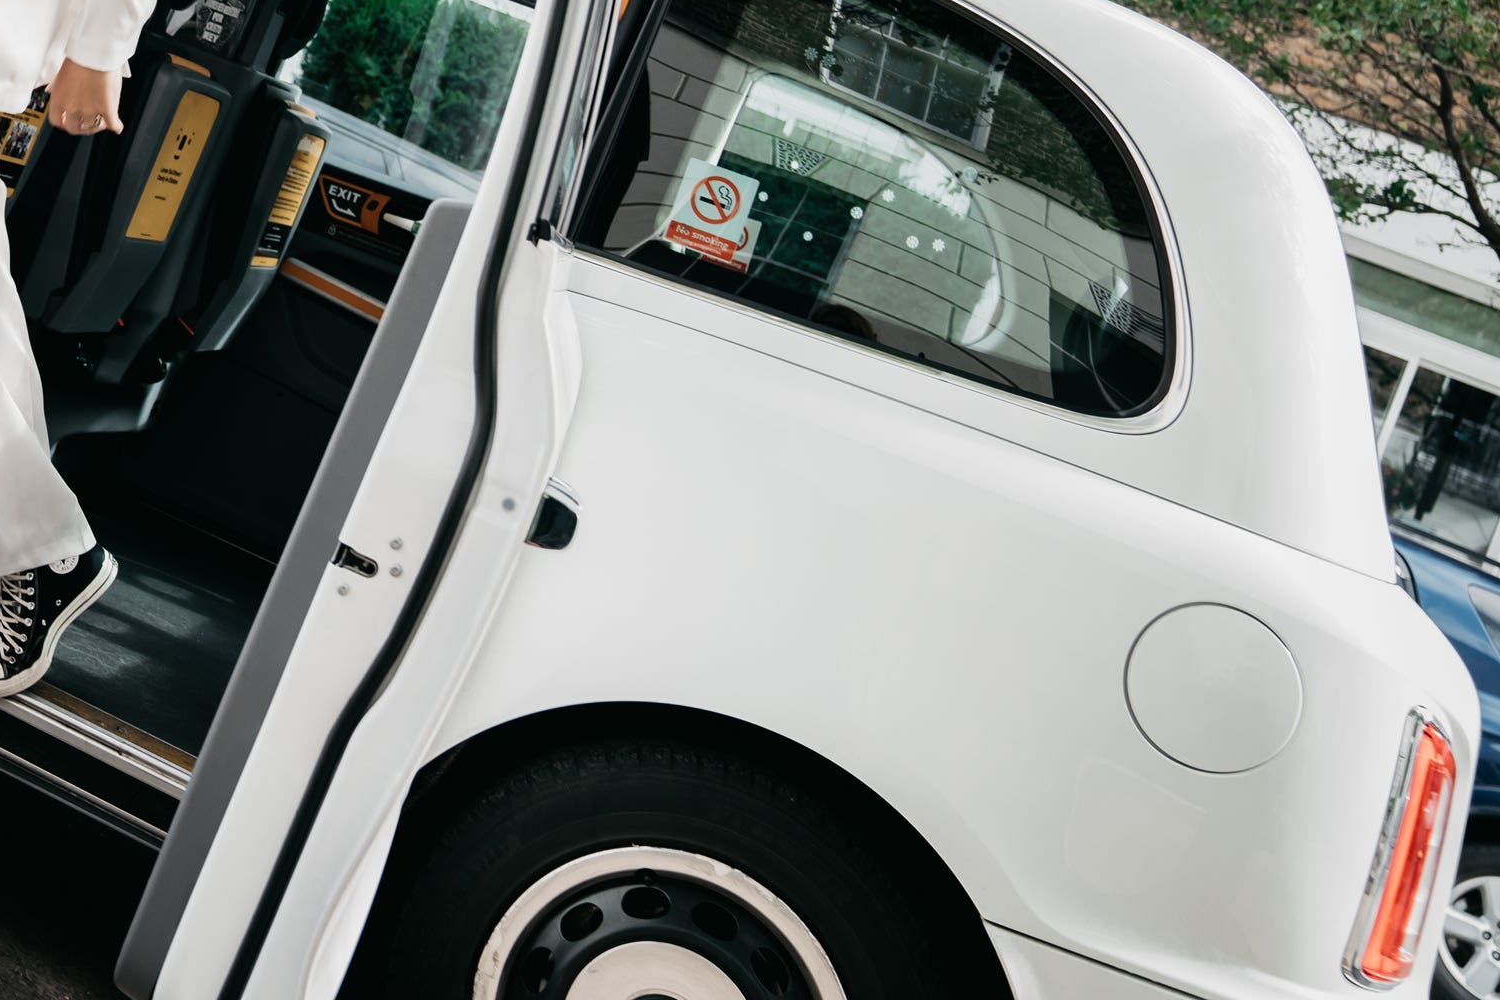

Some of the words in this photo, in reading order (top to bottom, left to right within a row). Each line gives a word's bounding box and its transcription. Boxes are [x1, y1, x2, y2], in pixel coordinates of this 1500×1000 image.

[328, 184, 361, 203] EXIT
[676, 225, 690, 236] No
[691, 232, 729, 251] smoking
